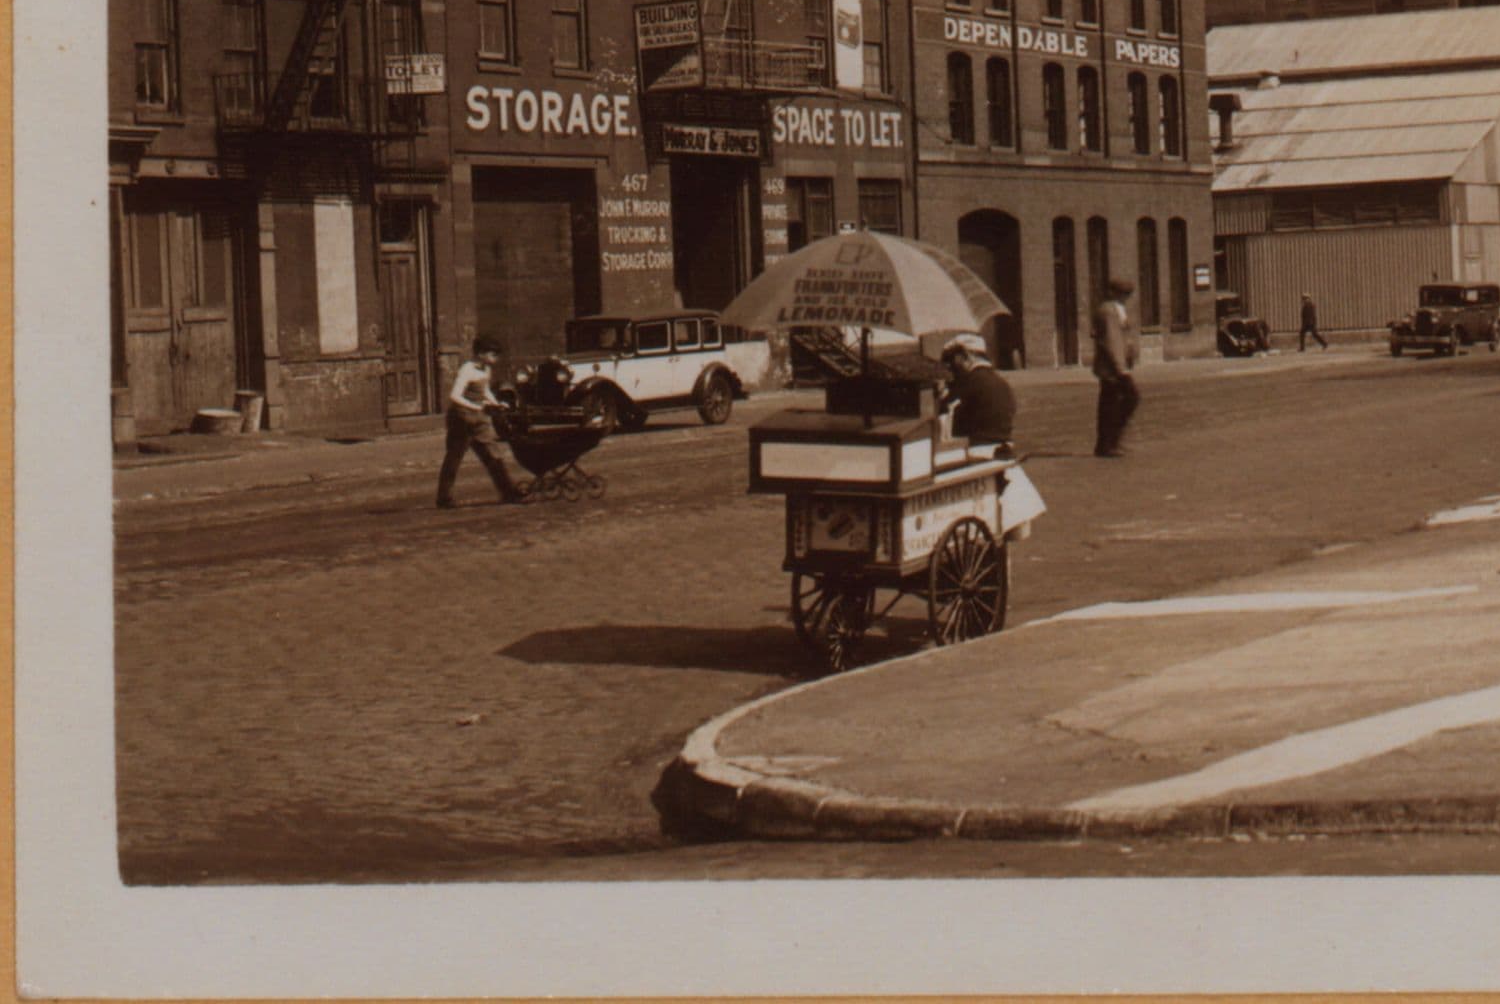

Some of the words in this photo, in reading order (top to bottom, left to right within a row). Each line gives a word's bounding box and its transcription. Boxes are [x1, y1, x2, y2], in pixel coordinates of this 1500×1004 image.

[640, 3, 698, 24] BUILDING
[944, 17, 1088, 57] DEPENDABLE
[1115, 39, 1180, 68] PAPERS
[466, 85, 637, 137] STORAGE.
[773, 106, 835, 146] SPACE
[840, 108, 865, 147] TO
[870, 110, 904, 148] LET.
[622, 174, 648, 192] 467
[608, 226, 657, 244] TRUCKING
[777, 307, 896, 327] LEMONADE
